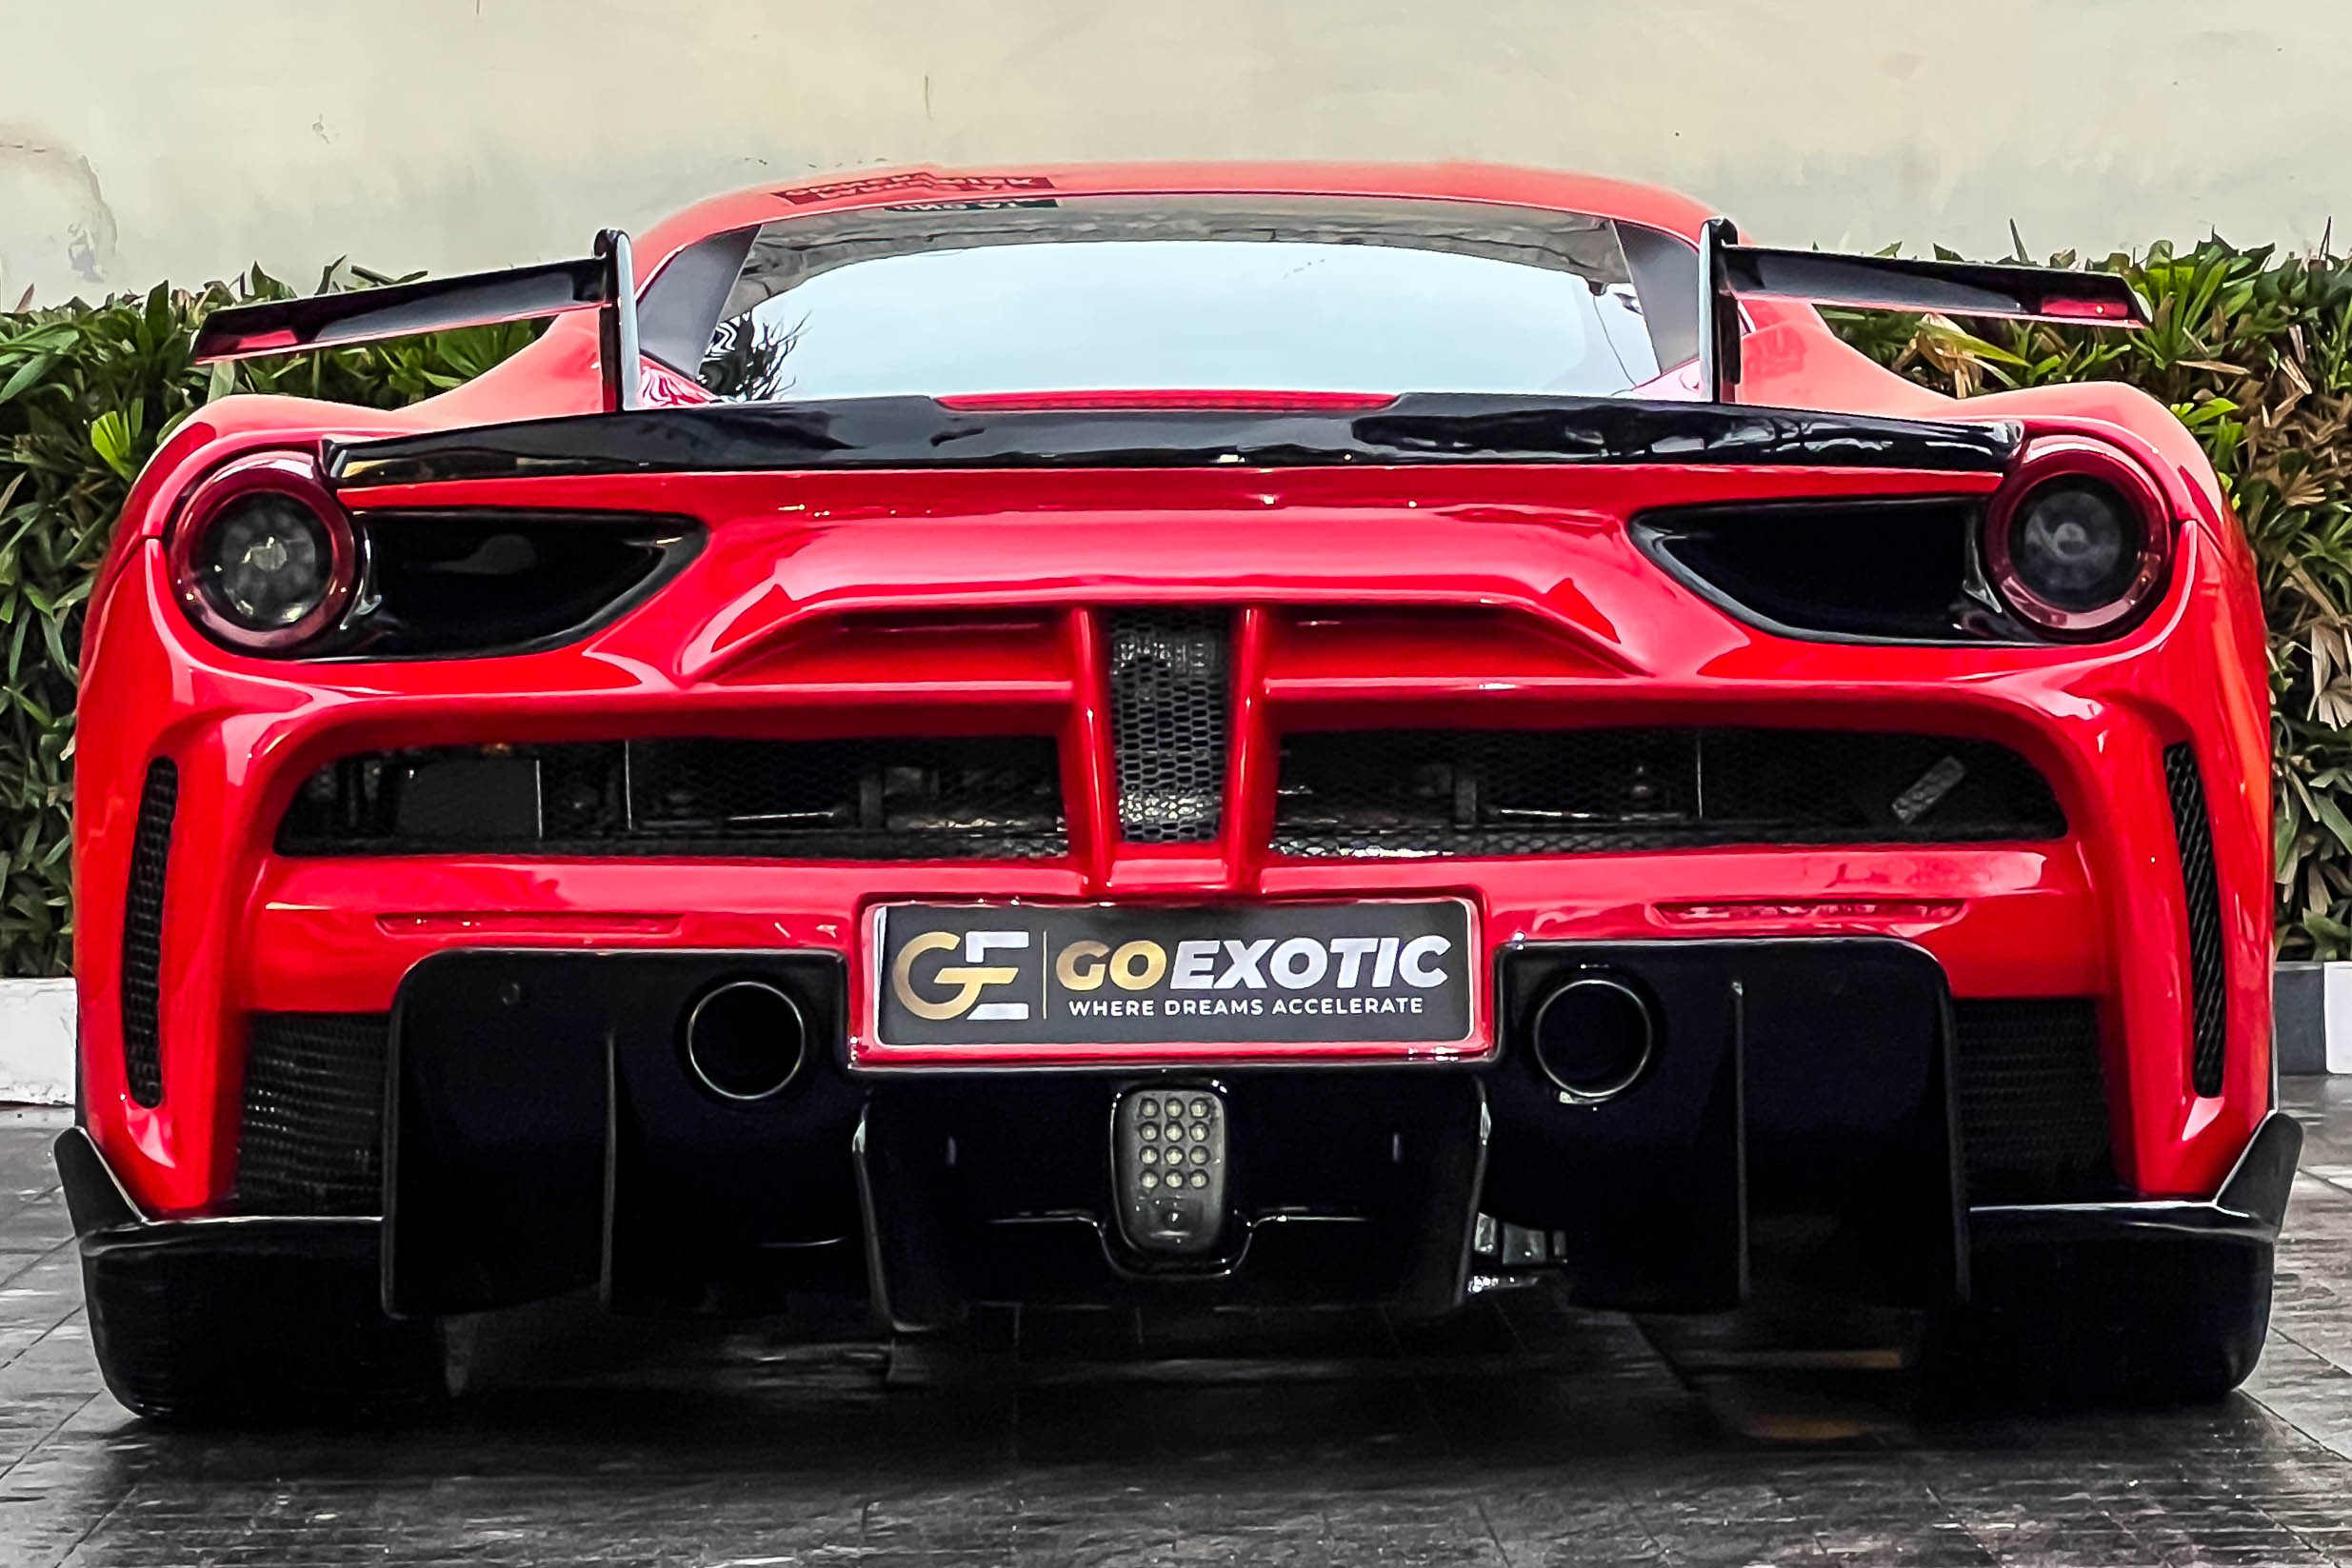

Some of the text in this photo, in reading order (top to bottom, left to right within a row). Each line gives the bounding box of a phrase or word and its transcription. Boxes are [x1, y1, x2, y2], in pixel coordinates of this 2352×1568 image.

[1068, 997, 1424, 1018] WHERE DREAMS ACCELERATE
